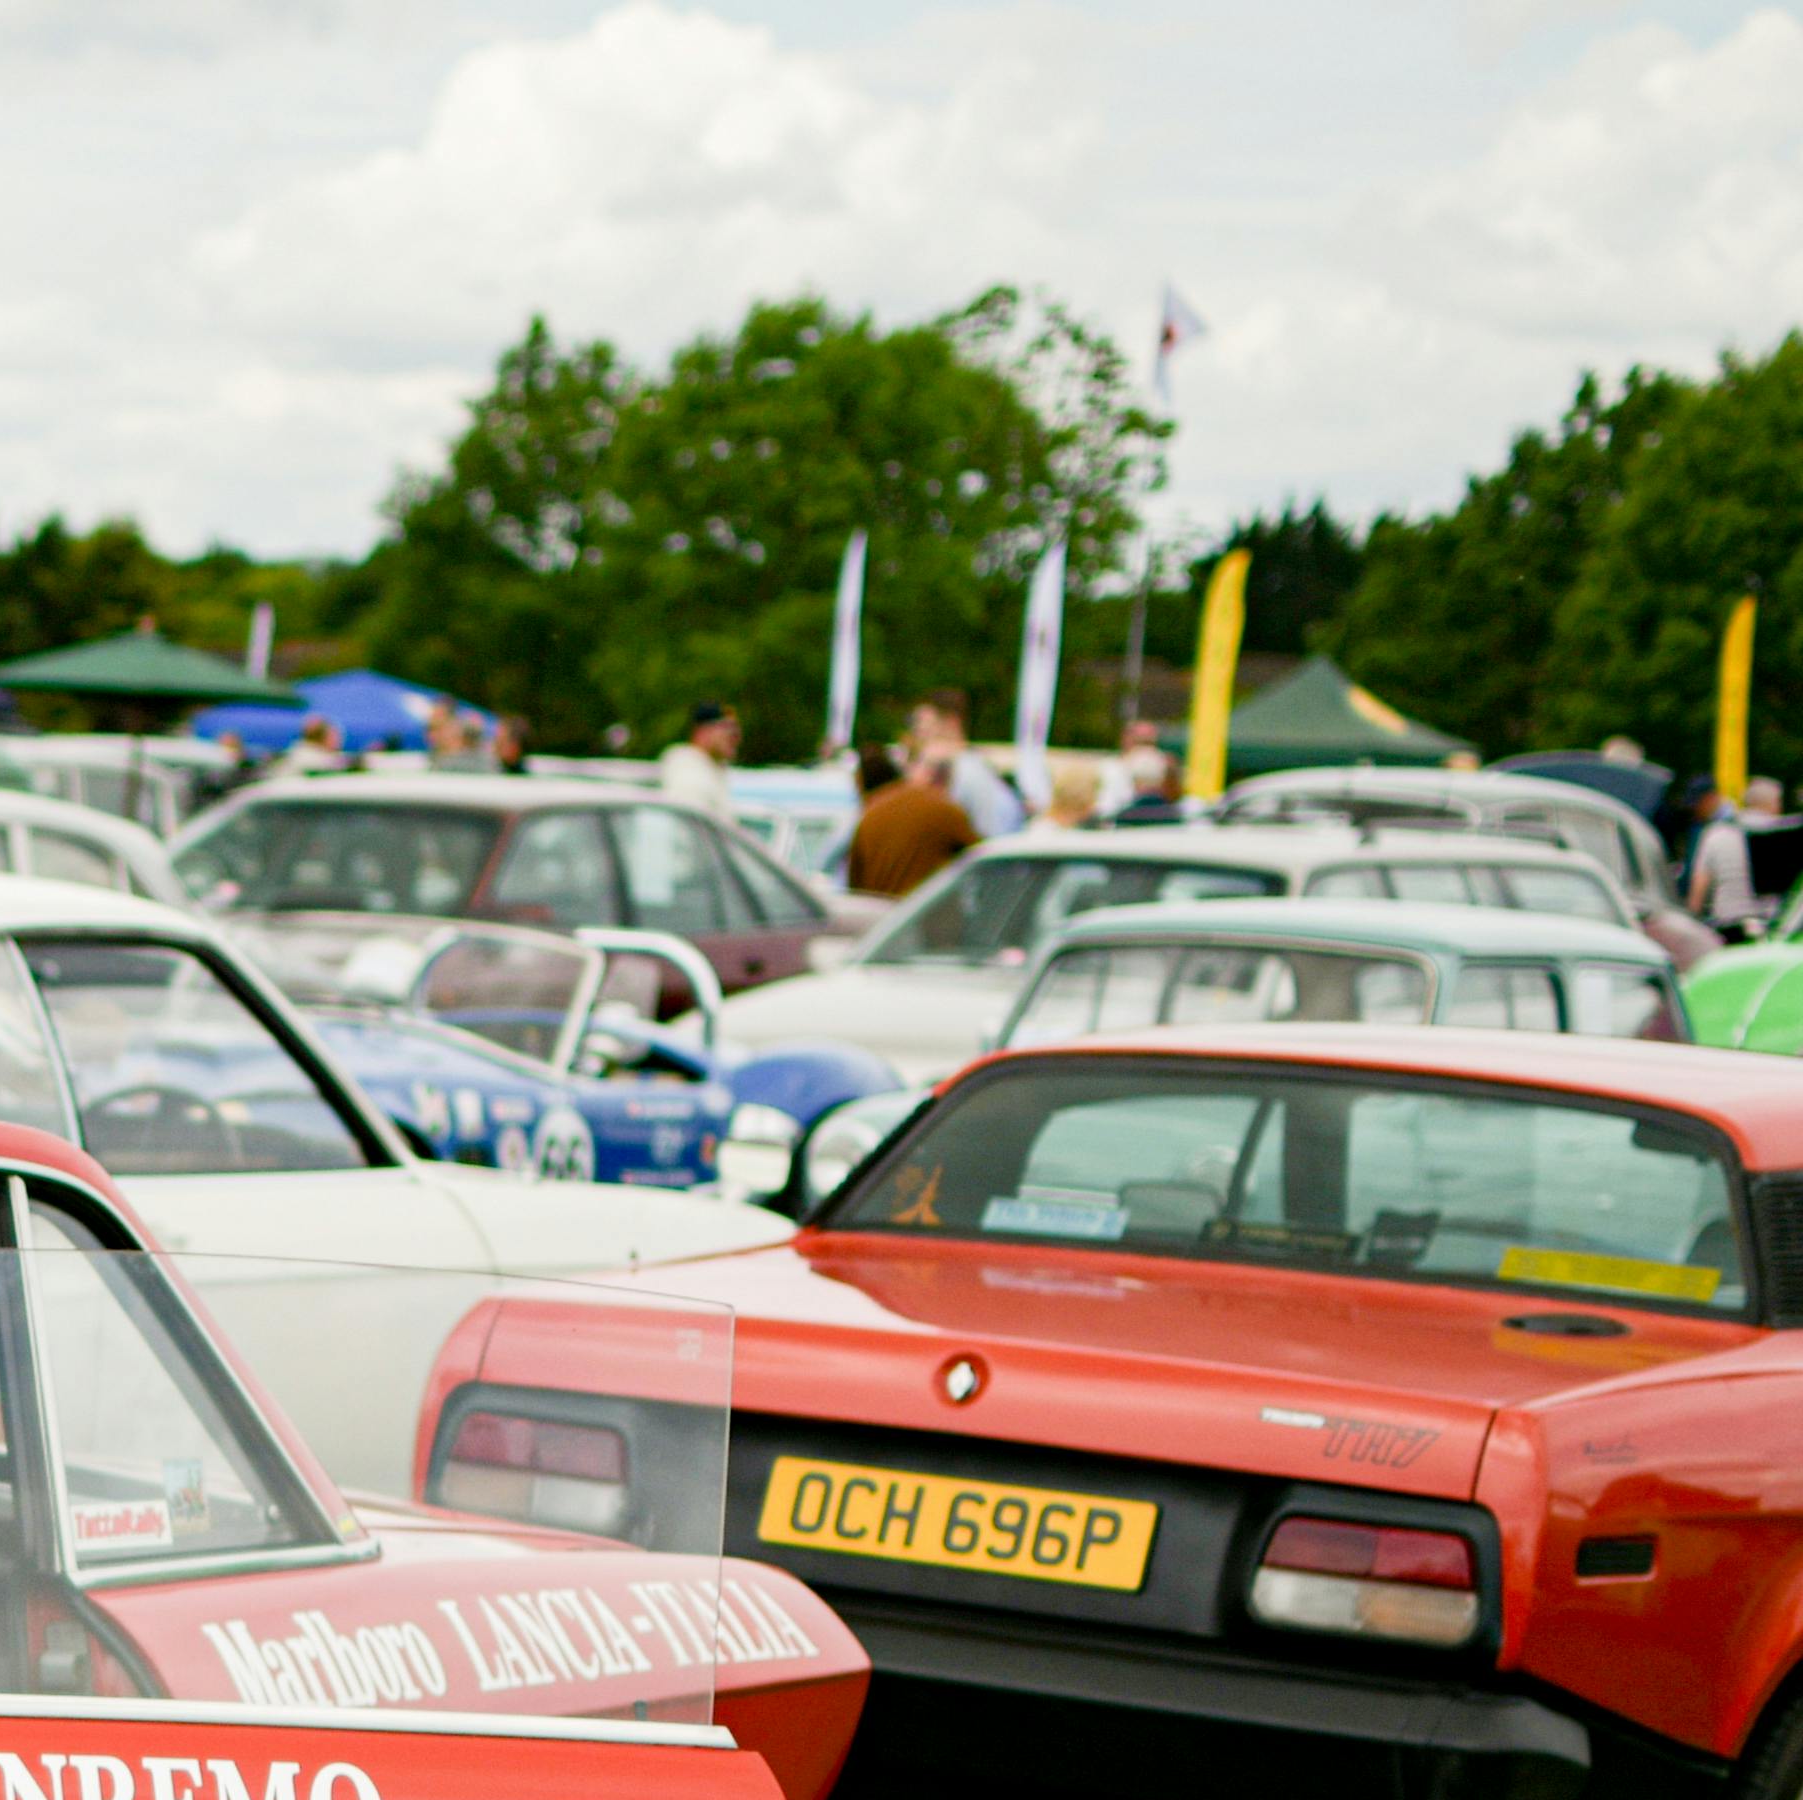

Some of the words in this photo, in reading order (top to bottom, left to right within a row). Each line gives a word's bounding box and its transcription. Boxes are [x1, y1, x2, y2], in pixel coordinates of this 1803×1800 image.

[789, 1471, 925, 1548] OCH
[943, 1491, 1123, 1570] 696P
[201, 1608, 448, 1706] Marlboro
